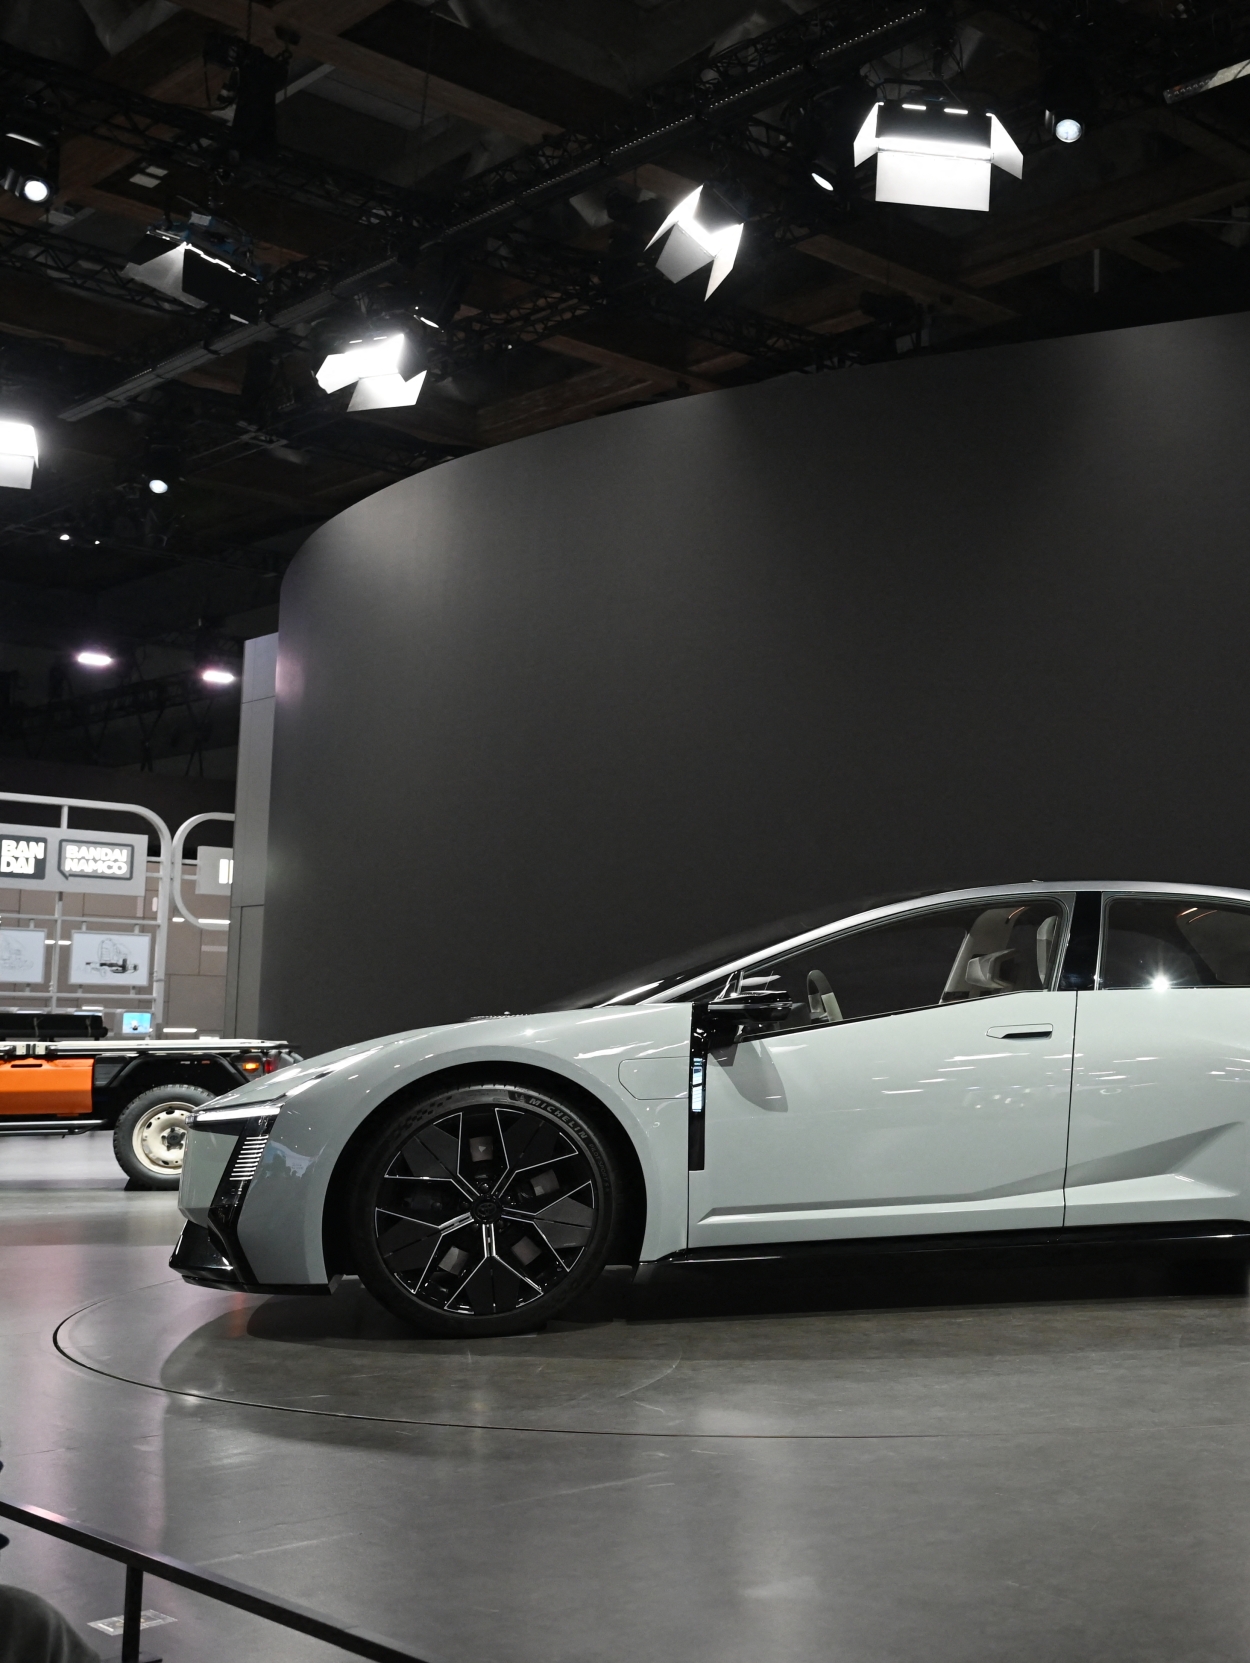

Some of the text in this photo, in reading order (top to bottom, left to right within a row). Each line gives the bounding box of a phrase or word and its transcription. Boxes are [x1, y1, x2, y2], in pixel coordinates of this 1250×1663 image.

[2, 839, 45, 859] BAN
[66, 845, 127, 862] BANDAI
[0, 856, 35, 874] DAI
[65, 858, 127, 875] NAMCO
[529, 1099, 588, 1139] MICHELIN
